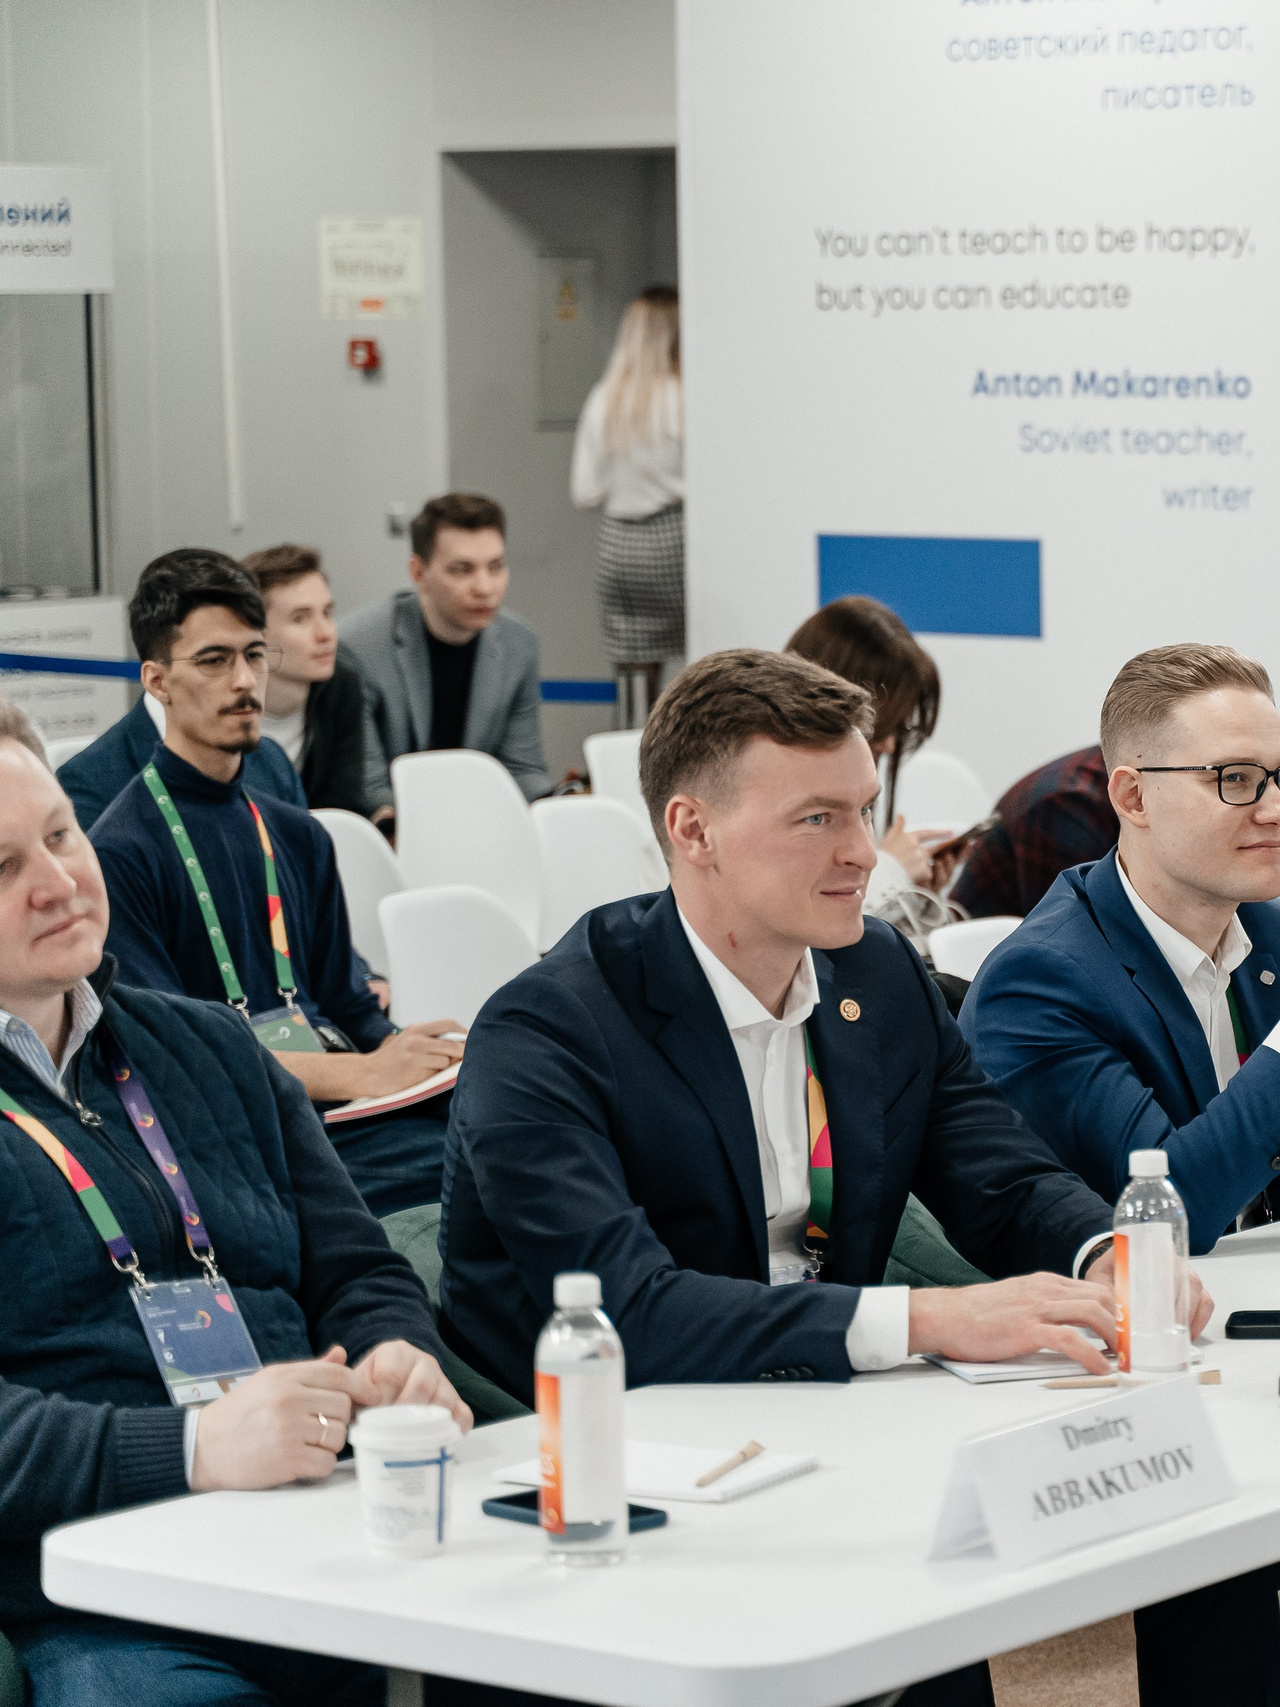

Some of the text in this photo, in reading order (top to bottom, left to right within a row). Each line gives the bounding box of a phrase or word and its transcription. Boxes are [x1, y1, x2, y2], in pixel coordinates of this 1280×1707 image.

[946, 24, 1254, 62] советский педагог,
[1101, 82, 1256, 110] писатель
[814, 221, 1256, 260] You can't teach to be happy,
[815, 278, 1132, 318] but you can educate
[972, 368, 1252, 400] Anton Makarenko
[1018, 423, 1254, 461] Soviet teacher,
[1160, 481, 1255, 511] writer
[1060, 1415, 1135, 1451] Dmitry
[1032, 1444, 1195, 1521] ABBAKUMOV
